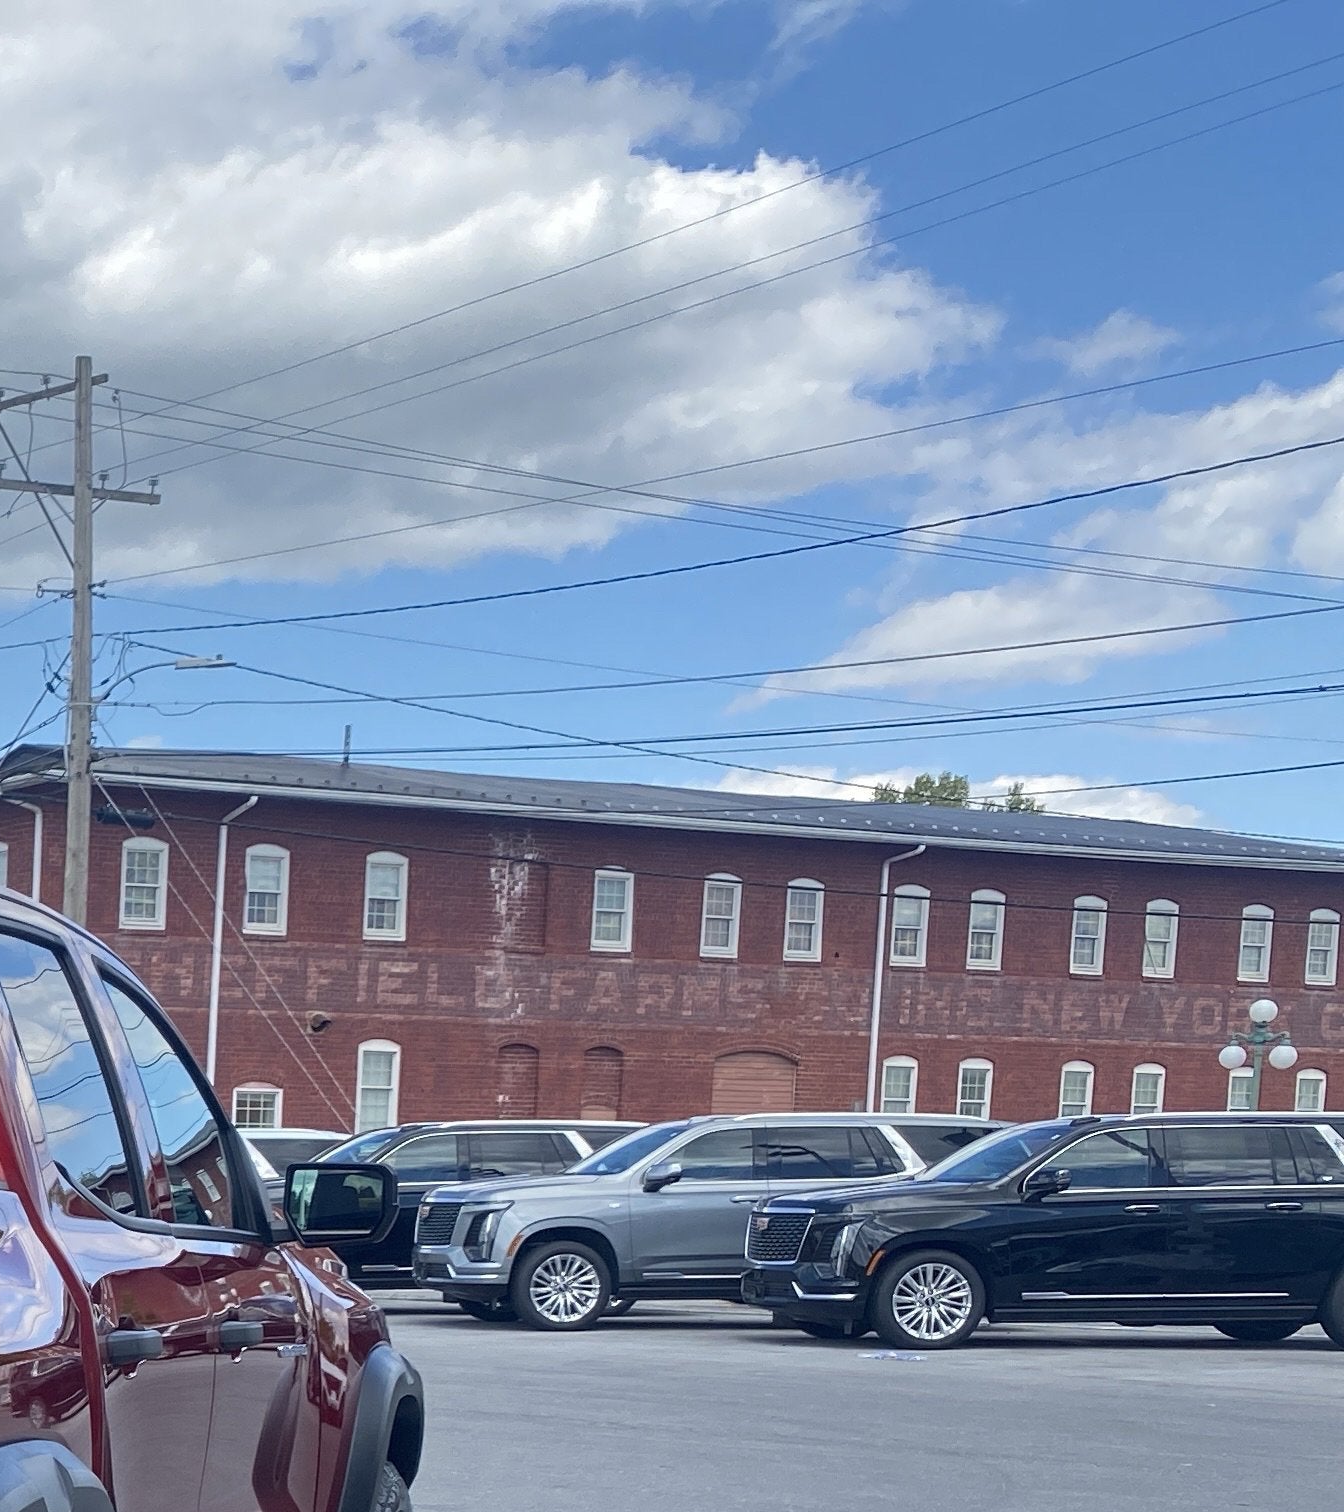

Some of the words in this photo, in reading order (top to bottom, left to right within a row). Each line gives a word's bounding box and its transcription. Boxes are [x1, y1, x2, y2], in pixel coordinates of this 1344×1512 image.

[118, 948, 515, 1010] HEFFIELD
[548, 968, 771, 1019] FARMS
[1022, 990, 1131, 1032] NEW
